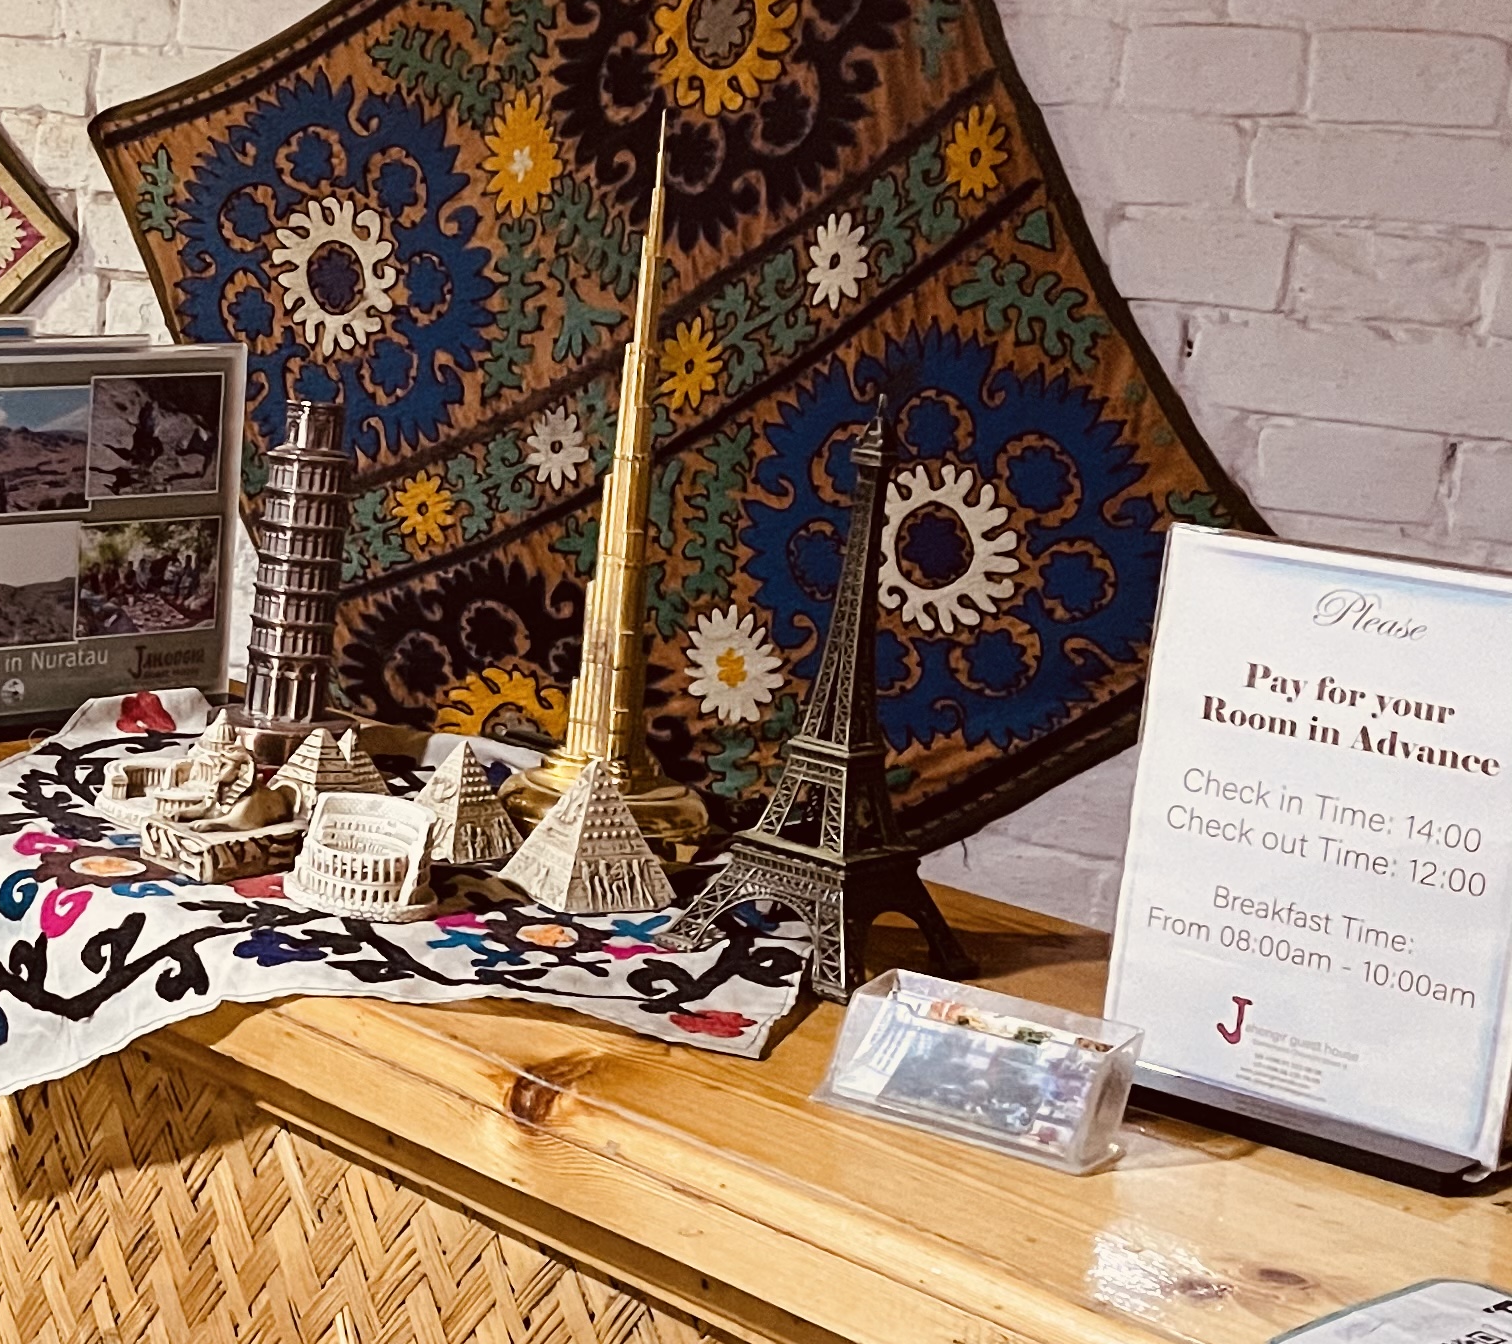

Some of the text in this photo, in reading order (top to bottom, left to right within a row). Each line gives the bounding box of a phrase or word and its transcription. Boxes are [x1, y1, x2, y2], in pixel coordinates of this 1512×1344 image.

[1313, 589, 1428, 641] Please
[5, 655, 23, 673] in
[31, 648, 109, 671] Nuratau
[1243, 661, 1456, 724] Pay for your
[1201, 695, 1502, 777] Room in Advance
[1184, 768, 1482, 853] Check in Time: 14:00
[1167, 805, 1487, 897] Check out Time: 12:00
[1148, 906, 1210, 942] From
[1220, 926, 1332, 973] 08:00am
[1363, 961, 1476, 1009] 10:00am
[1213, 885, 1415, 955] Breakfast Time:
